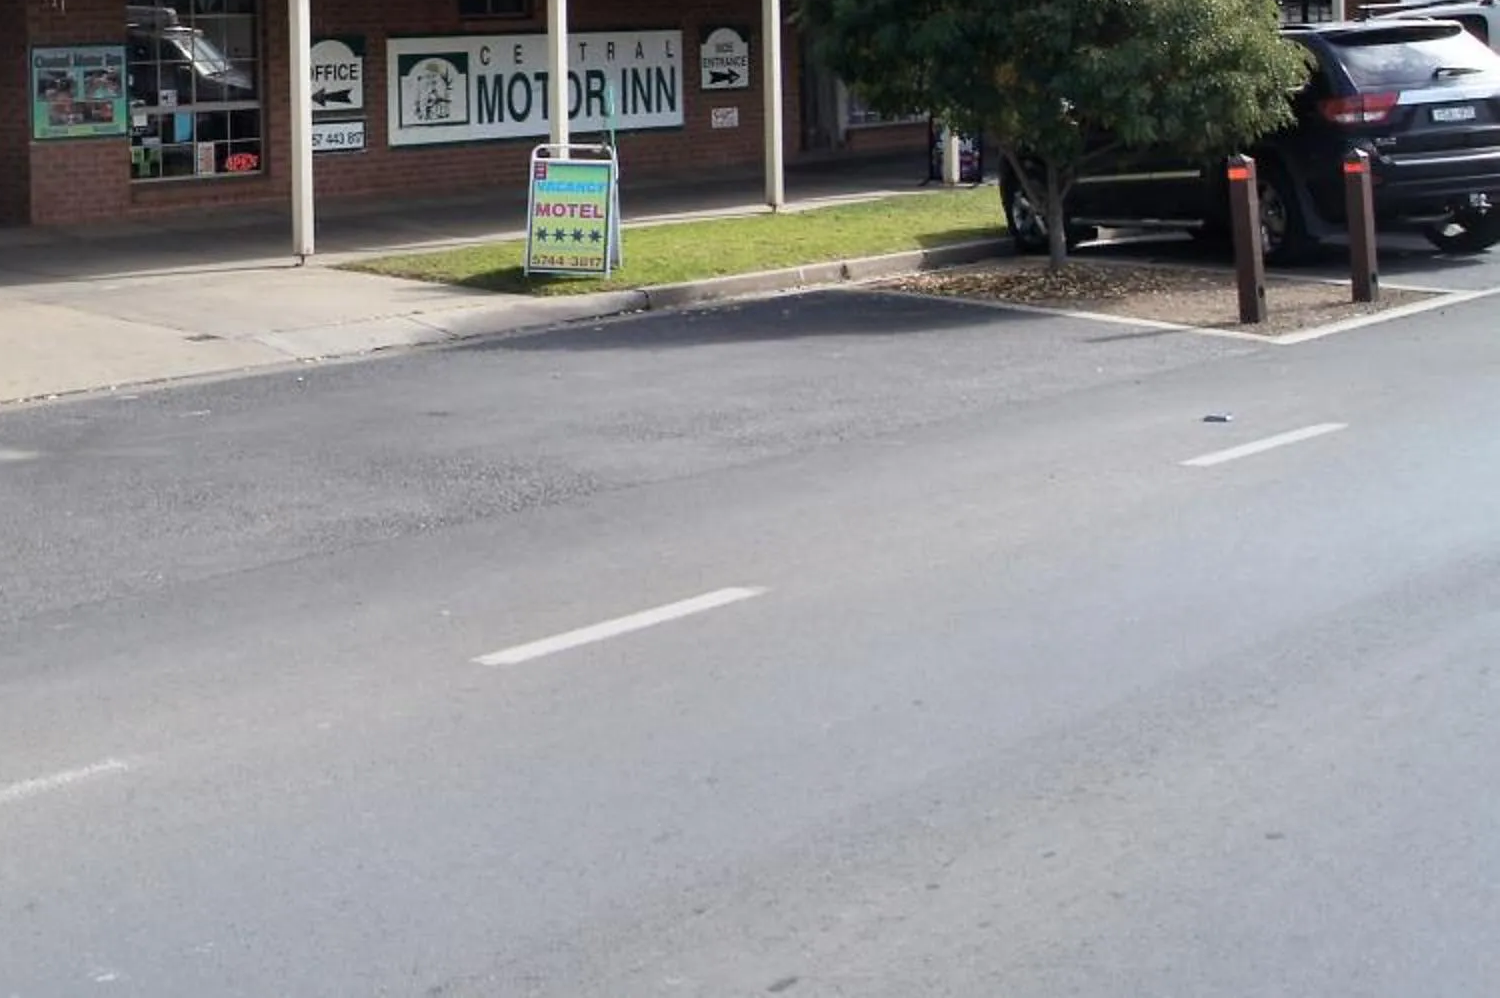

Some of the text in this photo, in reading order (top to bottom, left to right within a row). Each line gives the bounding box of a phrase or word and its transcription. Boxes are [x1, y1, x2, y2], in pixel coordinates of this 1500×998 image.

[479, 39, 674, 65] CETRAL
[621, 65, 677, 115] INN
[534, 203, 604, 219] MOTEL
